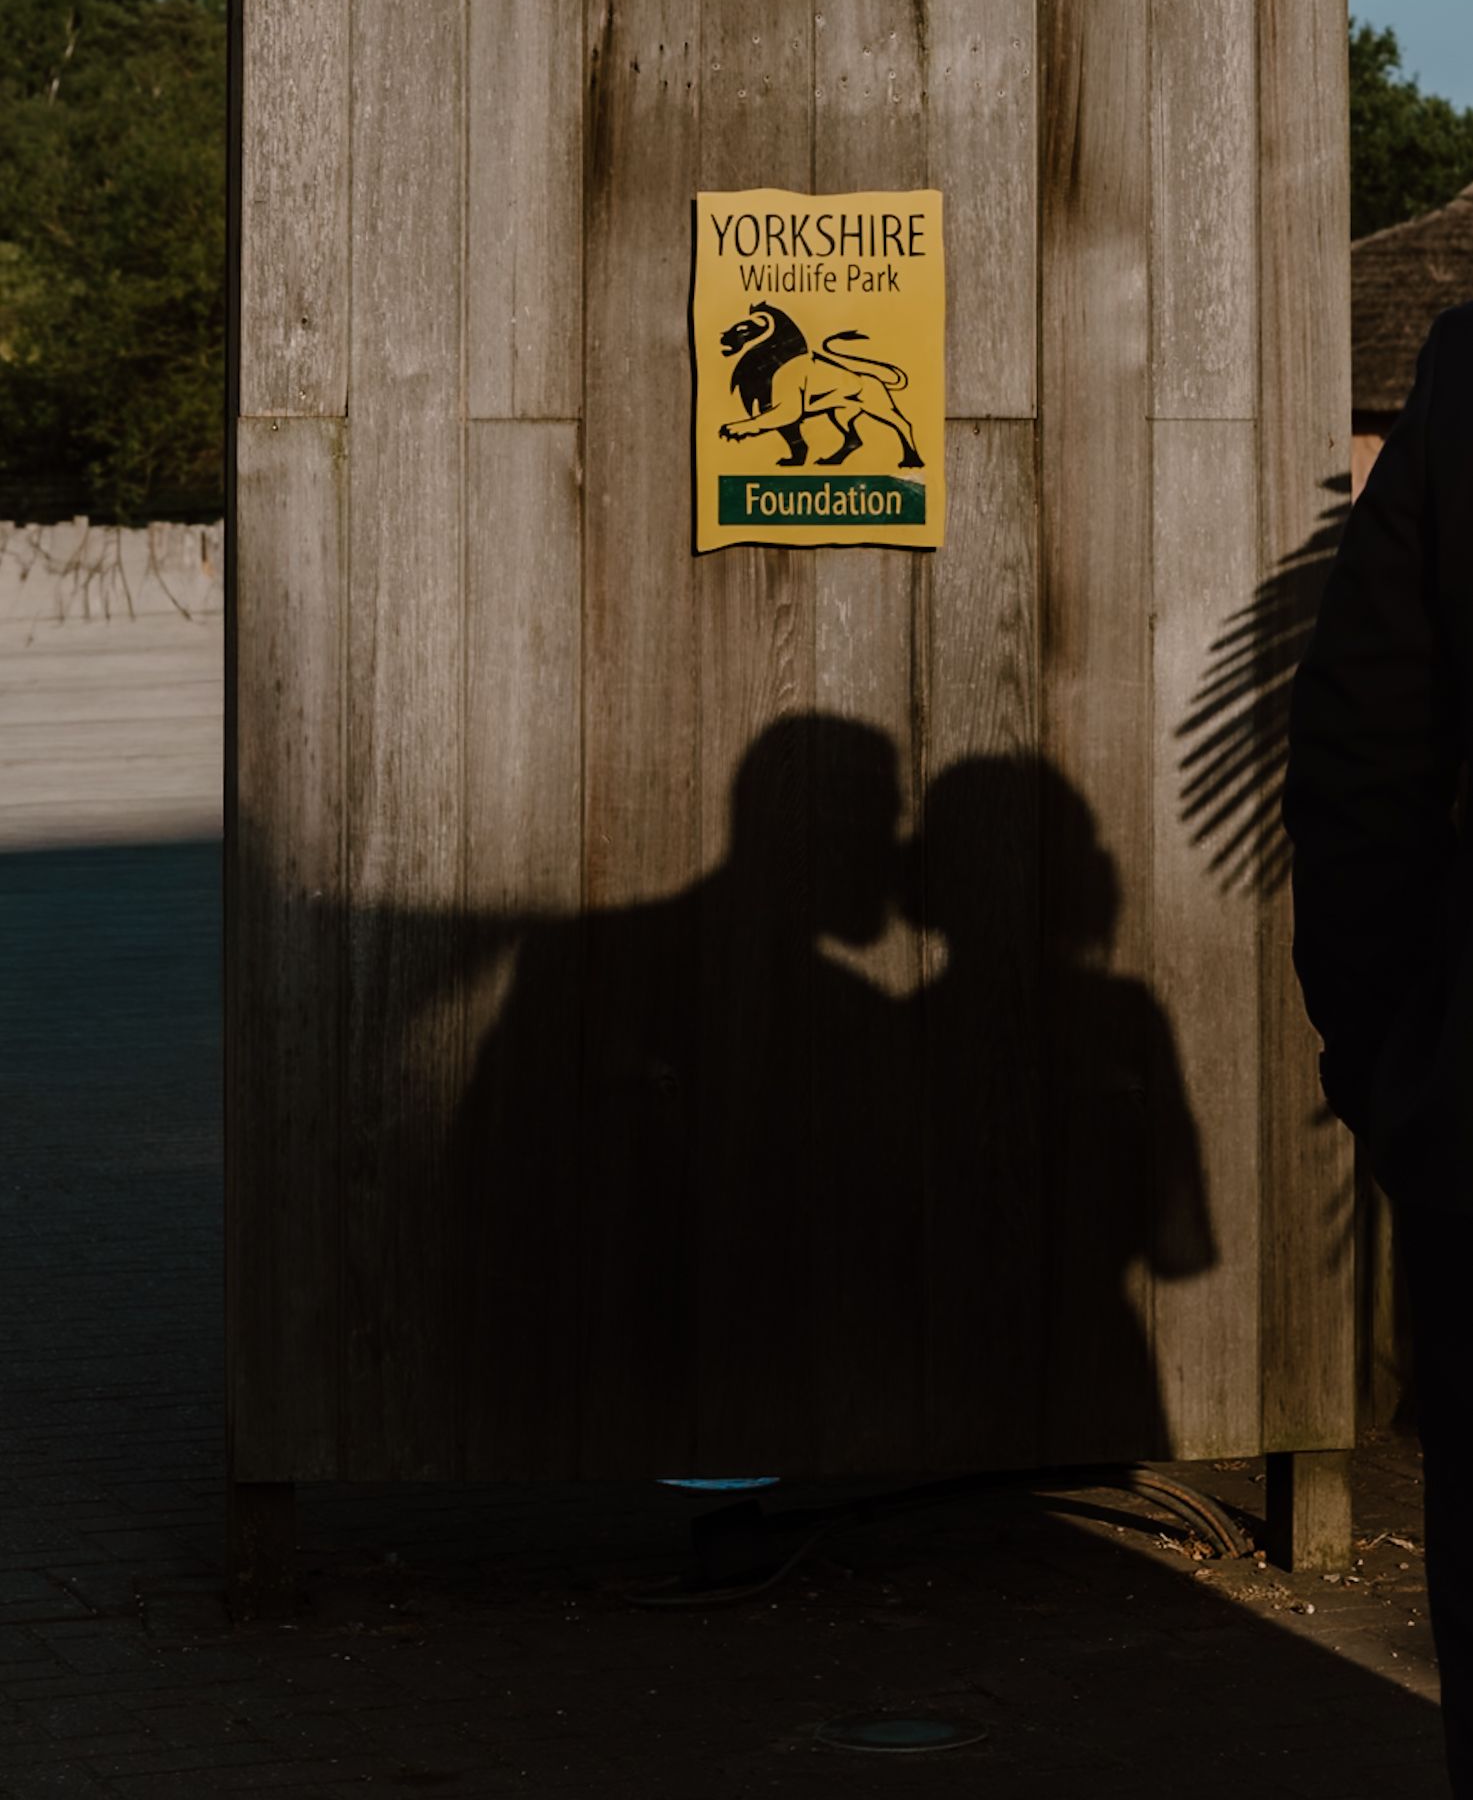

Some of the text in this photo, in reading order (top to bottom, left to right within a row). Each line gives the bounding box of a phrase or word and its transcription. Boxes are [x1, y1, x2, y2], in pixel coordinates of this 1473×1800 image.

[710, 213, 926, 258] YORKSHIRE
[739, 263, 901, 293] Wildlife Park
[745, 482, 902, 517] Foundation
